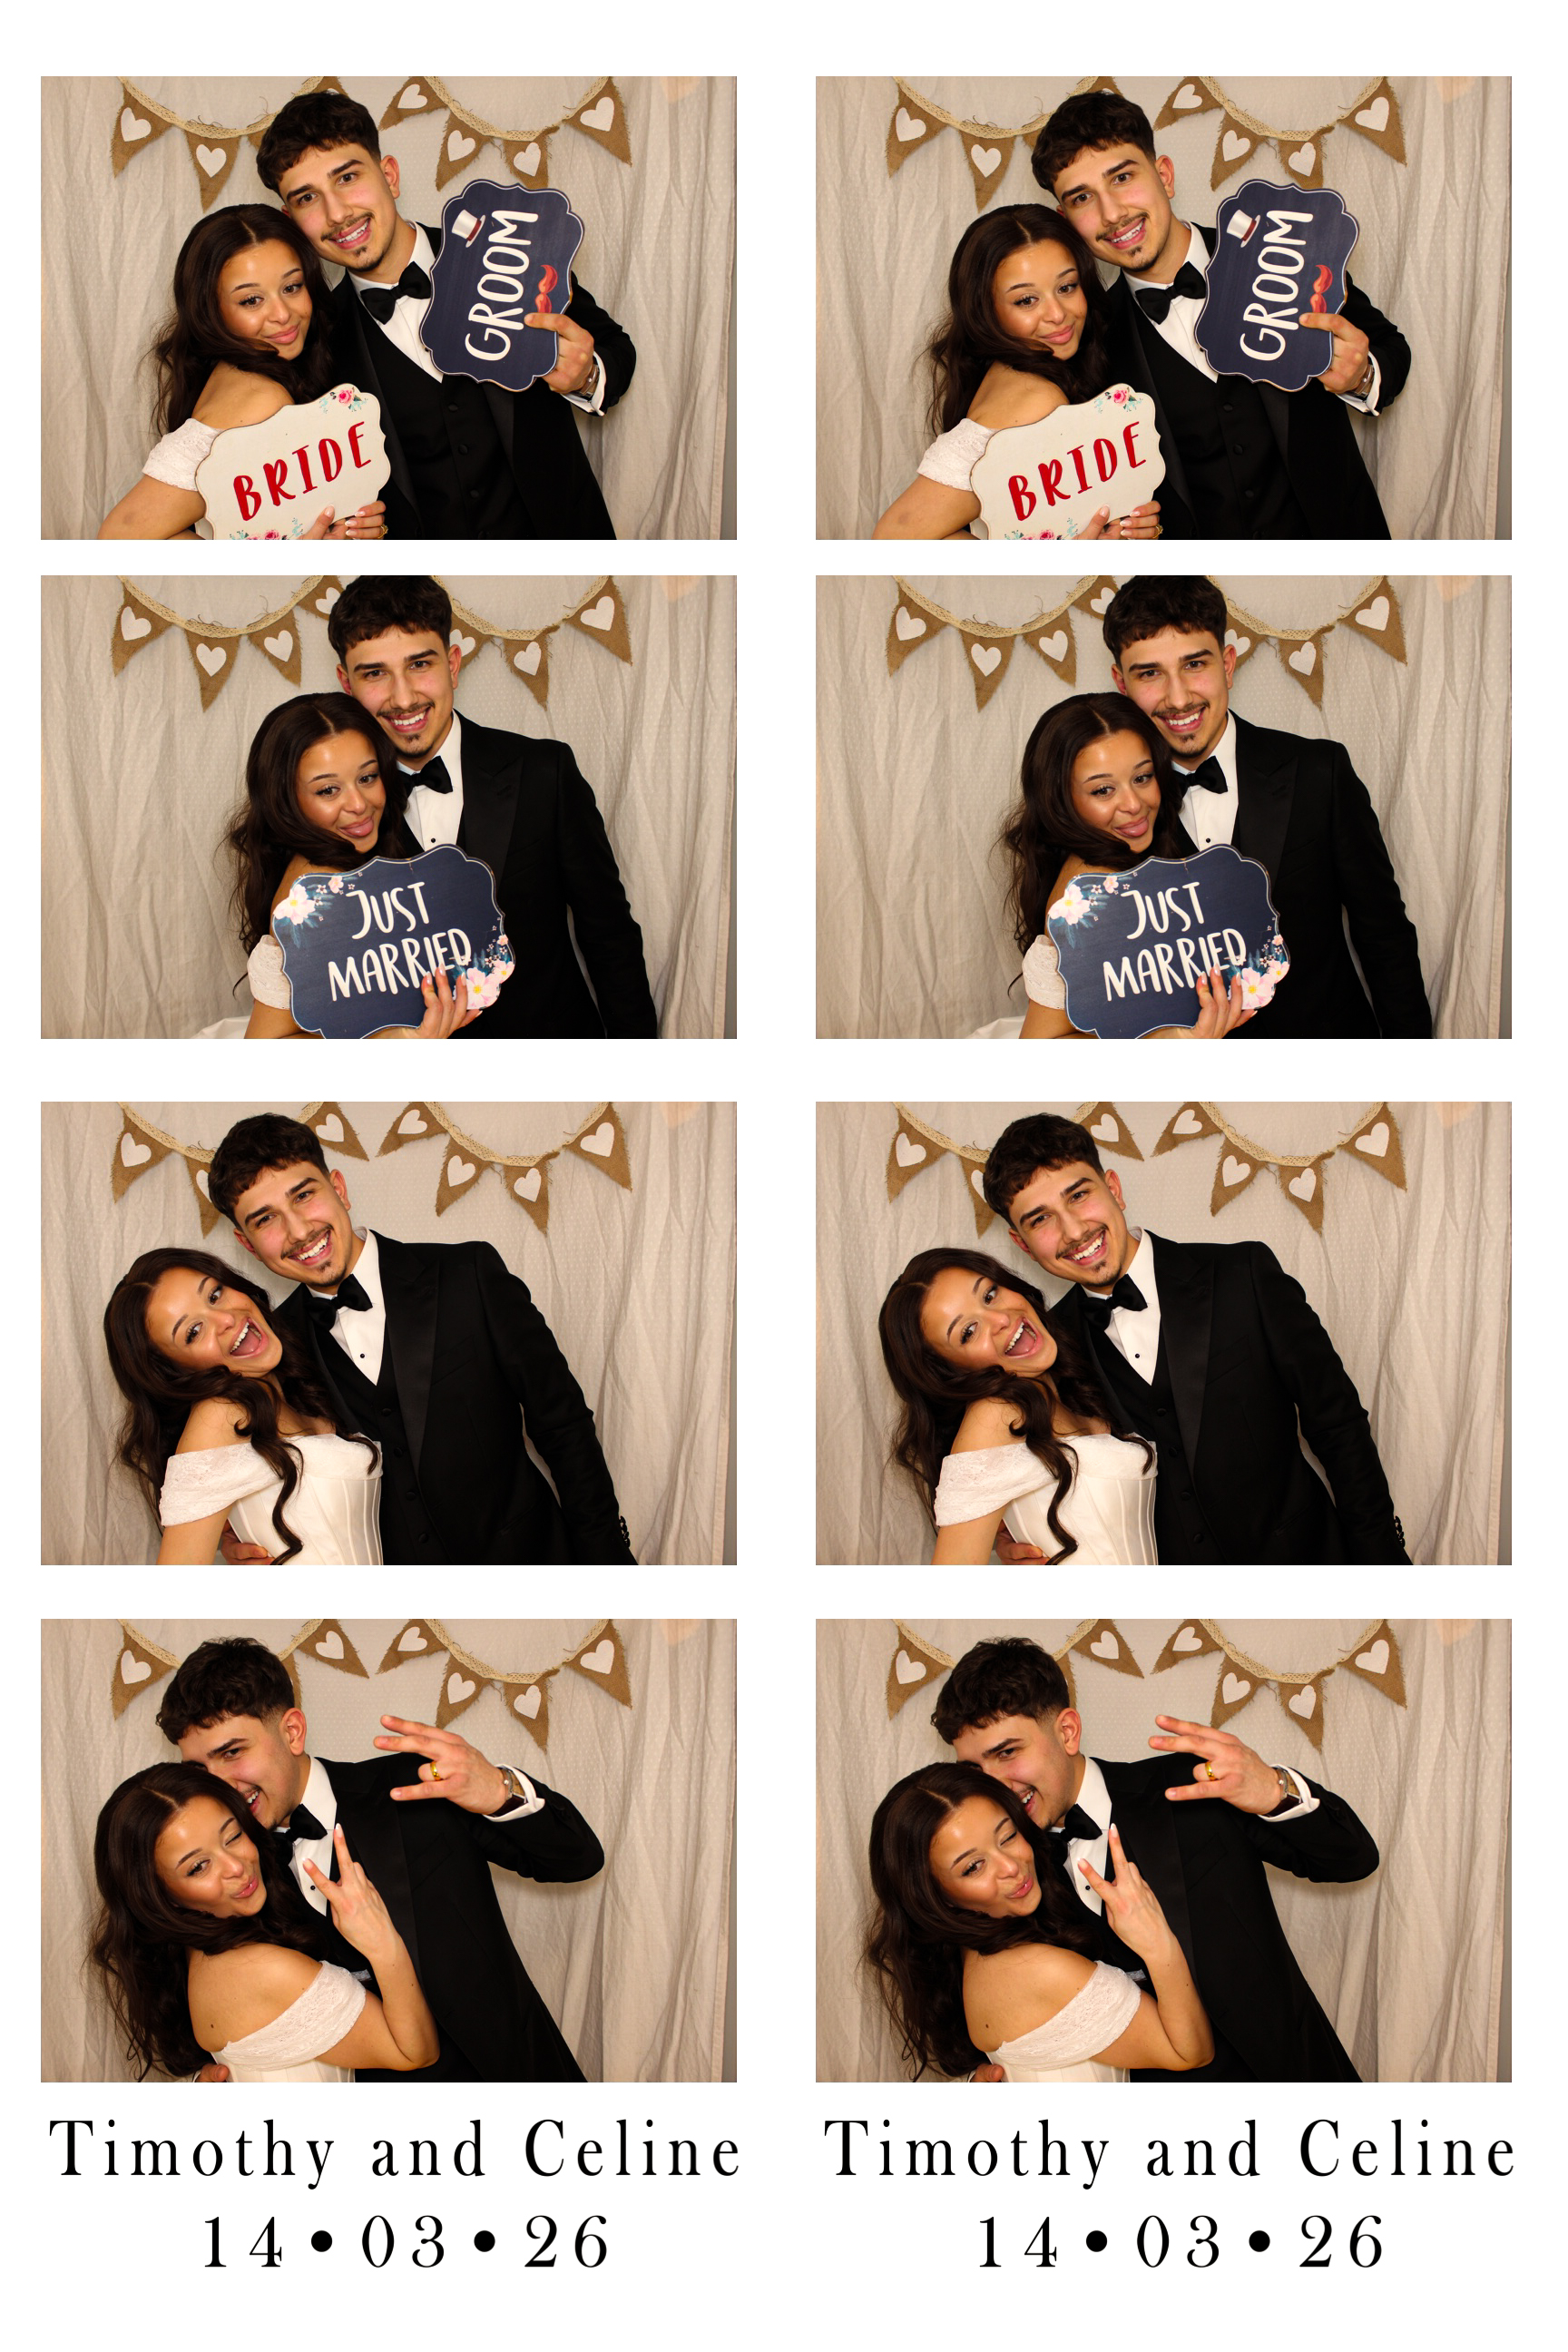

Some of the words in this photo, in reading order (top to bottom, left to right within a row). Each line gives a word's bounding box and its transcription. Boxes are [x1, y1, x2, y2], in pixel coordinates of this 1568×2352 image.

[465, 210, 539, 361] GROOM
[1240, 210, 1314, 361] GROOM
[233, 420, 372, 521] BRIDE
[1008, 420, 1147, 521] BRIDE
[346, 881, 430, 940] JUST
[1121, 881, 1205, 940] JUST
[328, 927, 473, 1002] MARRIED
[1102, 927, 1248, 1002] MARRIED
